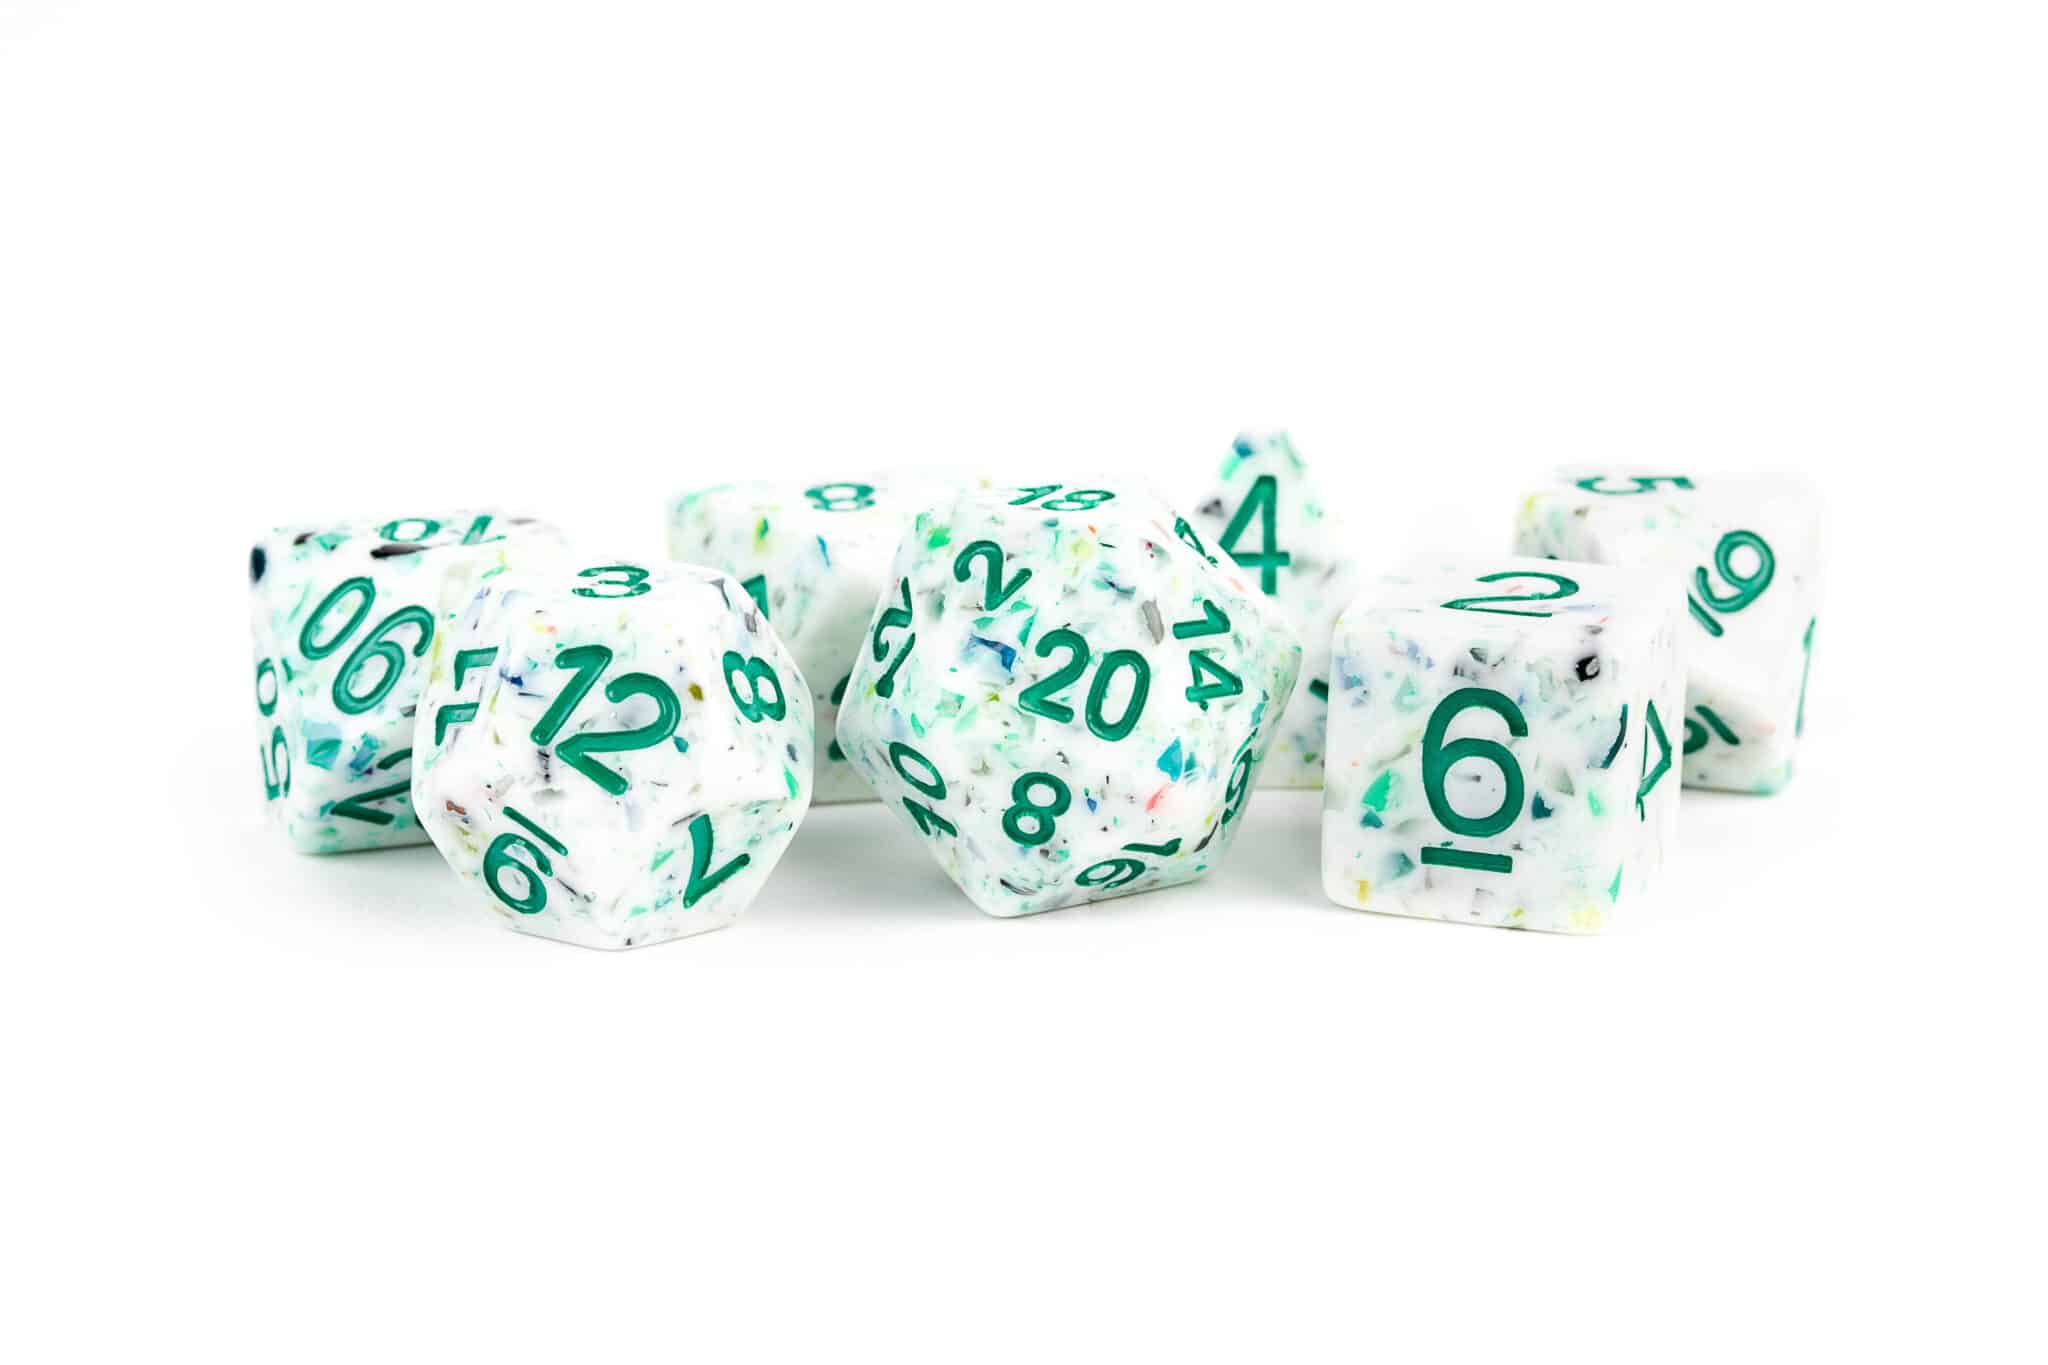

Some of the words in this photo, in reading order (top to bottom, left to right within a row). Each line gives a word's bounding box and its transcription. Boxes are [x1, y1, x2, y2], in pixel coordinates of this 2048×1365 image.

[803, 481, 877, 513] 8
[1008, 483, 1117, 513] 18
[1218, 474, 1291, 597] 4
[571, 564, 652, 600] 3
[953, 540, 1033, 611] 2
[1439, 571, 1581, 618] 2
[872, 576, 917, 699] 12
[1018, 628, 1150, 743] 20
[1172, 599, 1244, 711] 14
[435, 645, 500, 747] 11
[530, 644, 682, 796] 12
[722, 650, 787, 724] 8
[889, 741, 959, 839] 10
[1001, 771, 1073, 847] 8
[1420, 686, 1529, 839] 6
[682, 813, 752, 909] 7
